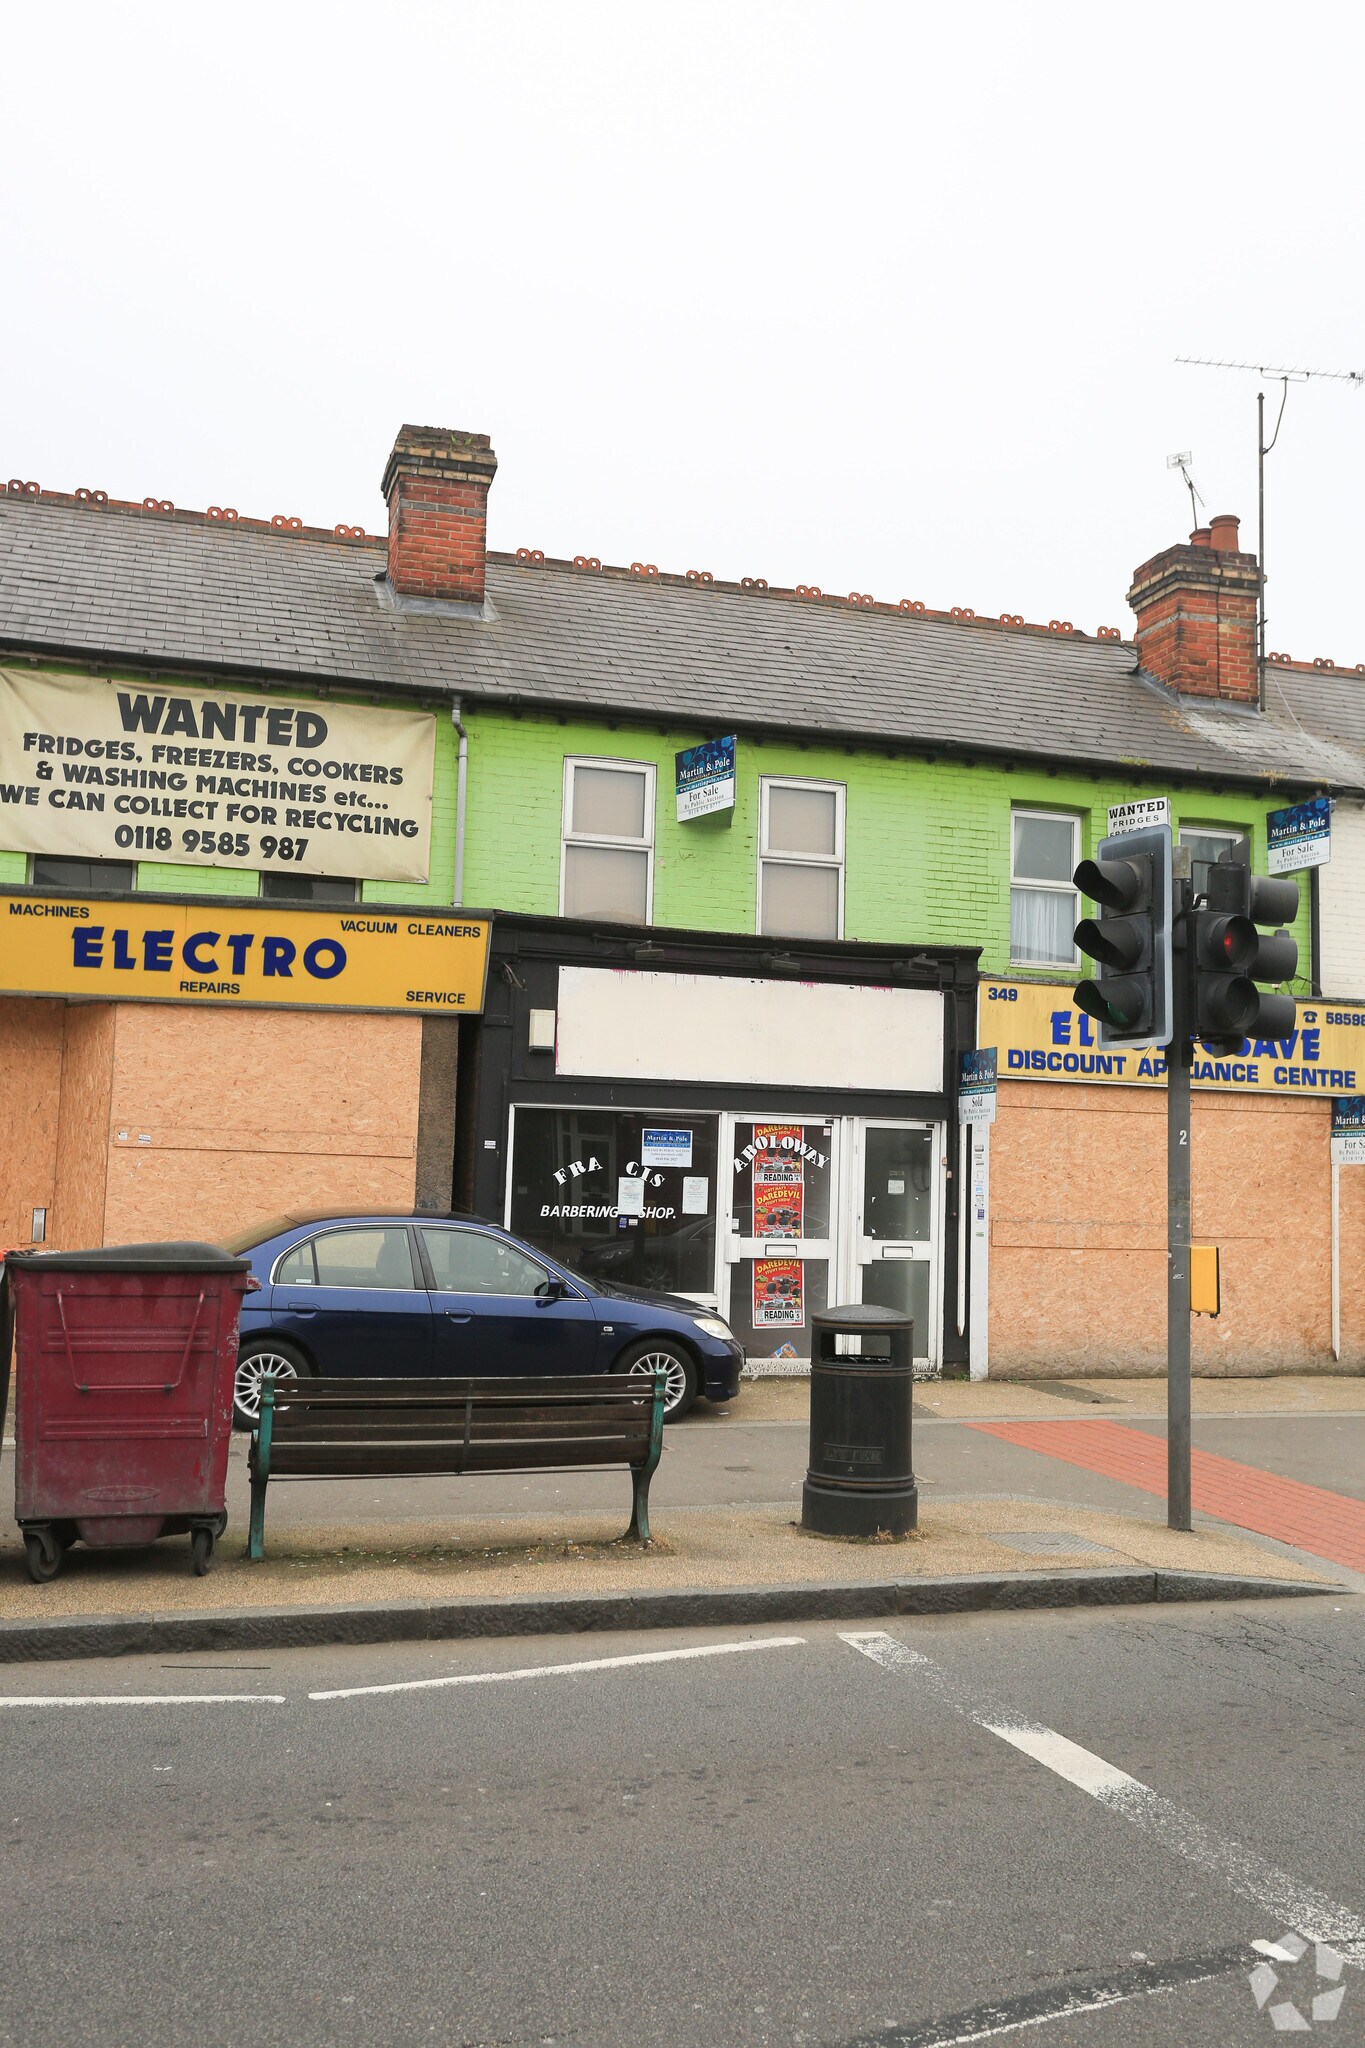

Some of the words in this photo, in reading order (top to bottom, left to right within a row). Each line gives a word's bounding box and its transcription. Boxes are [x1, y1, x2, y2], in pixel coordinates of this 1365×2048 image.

[116, 692, 328, 748] WANTED
[23, 732, 143, 763] FRIDGES,
[152, 744, 279, 776] FREEZERS,
[287, 757, 403, 786] COOKERS
[680, 766, 704, 780] Martin
[706, 762, 712, 772] &
[715, 757, 730, 769] Pole
[36, 760, 54, 781] &
[62, 763, 187, 791] WASHING
[196, 775, 326, 804] MACHINES
[333, 790, 389, 810] etc...
[689, 792, 700, 801] For
[703, 786, 719, 796] Sale
[0, 784, 39, 806] WE
[48, 789, 104, 812] CAN
[114, 794, 217, 820] COLLECT
[226, 803, 277, 825] FOR
[285, 809, 419, 838] RECYCLING
[1109, 801, 1165, 819] WANTED
[1113, 815, 1159, 828] FRIDGES
[1271, 825, 1297, 837] Martin
[1300, 822, 1306, 831] &
[1309, 818, 1326, 828] Pole
[114, 824, 172, 851] 0118
[182, 829, 250, 857] 9585
[260, 836, 309, 861] 987
[1282, 848, 1294, 857] For
[1297, 843, 1314, 854] Sale
[9, 903, 90, 918] MACHINES
[340, 920, 397, 934] VACUUM
[407, 923, 481, 938] CLEANERS
[71, 926, 347, 979] ELECTRO
[179, 981, 240, 994] REPAIRS
[989, 987, 1018, 1001] 349
[406, 991, 466, 1004] SERVICE
[1007, 1049, 1127, 1076] DISCOUNT
[961, 1072, 978, 1082] Martin
[979, 1070, 983, 1080] &
[984, 1068, 994, 1079] Pole
[1137, 1057, 1259, 1084] APIANCE
[1274, 1065, 1356, 1089] CENTRE
[972, 1096, 983, 1107] Sold
[1335, 1115, 1359, 1125] Martin
[1179, 1130, 1187, 1145] 2
[1344, 1140, 1356, 1149] For
[733, 1135, 830, 1174] ABOLOWAY
[763, 1173, 793, 1182] READING
[756, 1190, 801, 1205] DAREDEVIL
[540, 1205, 618, 1218] BARBERING
[638, 1207, 676, 1219] SHOP.
[756, 1259, 801, 1273] DAREDEVIL
[764, 1310, 794, 1319] READING
